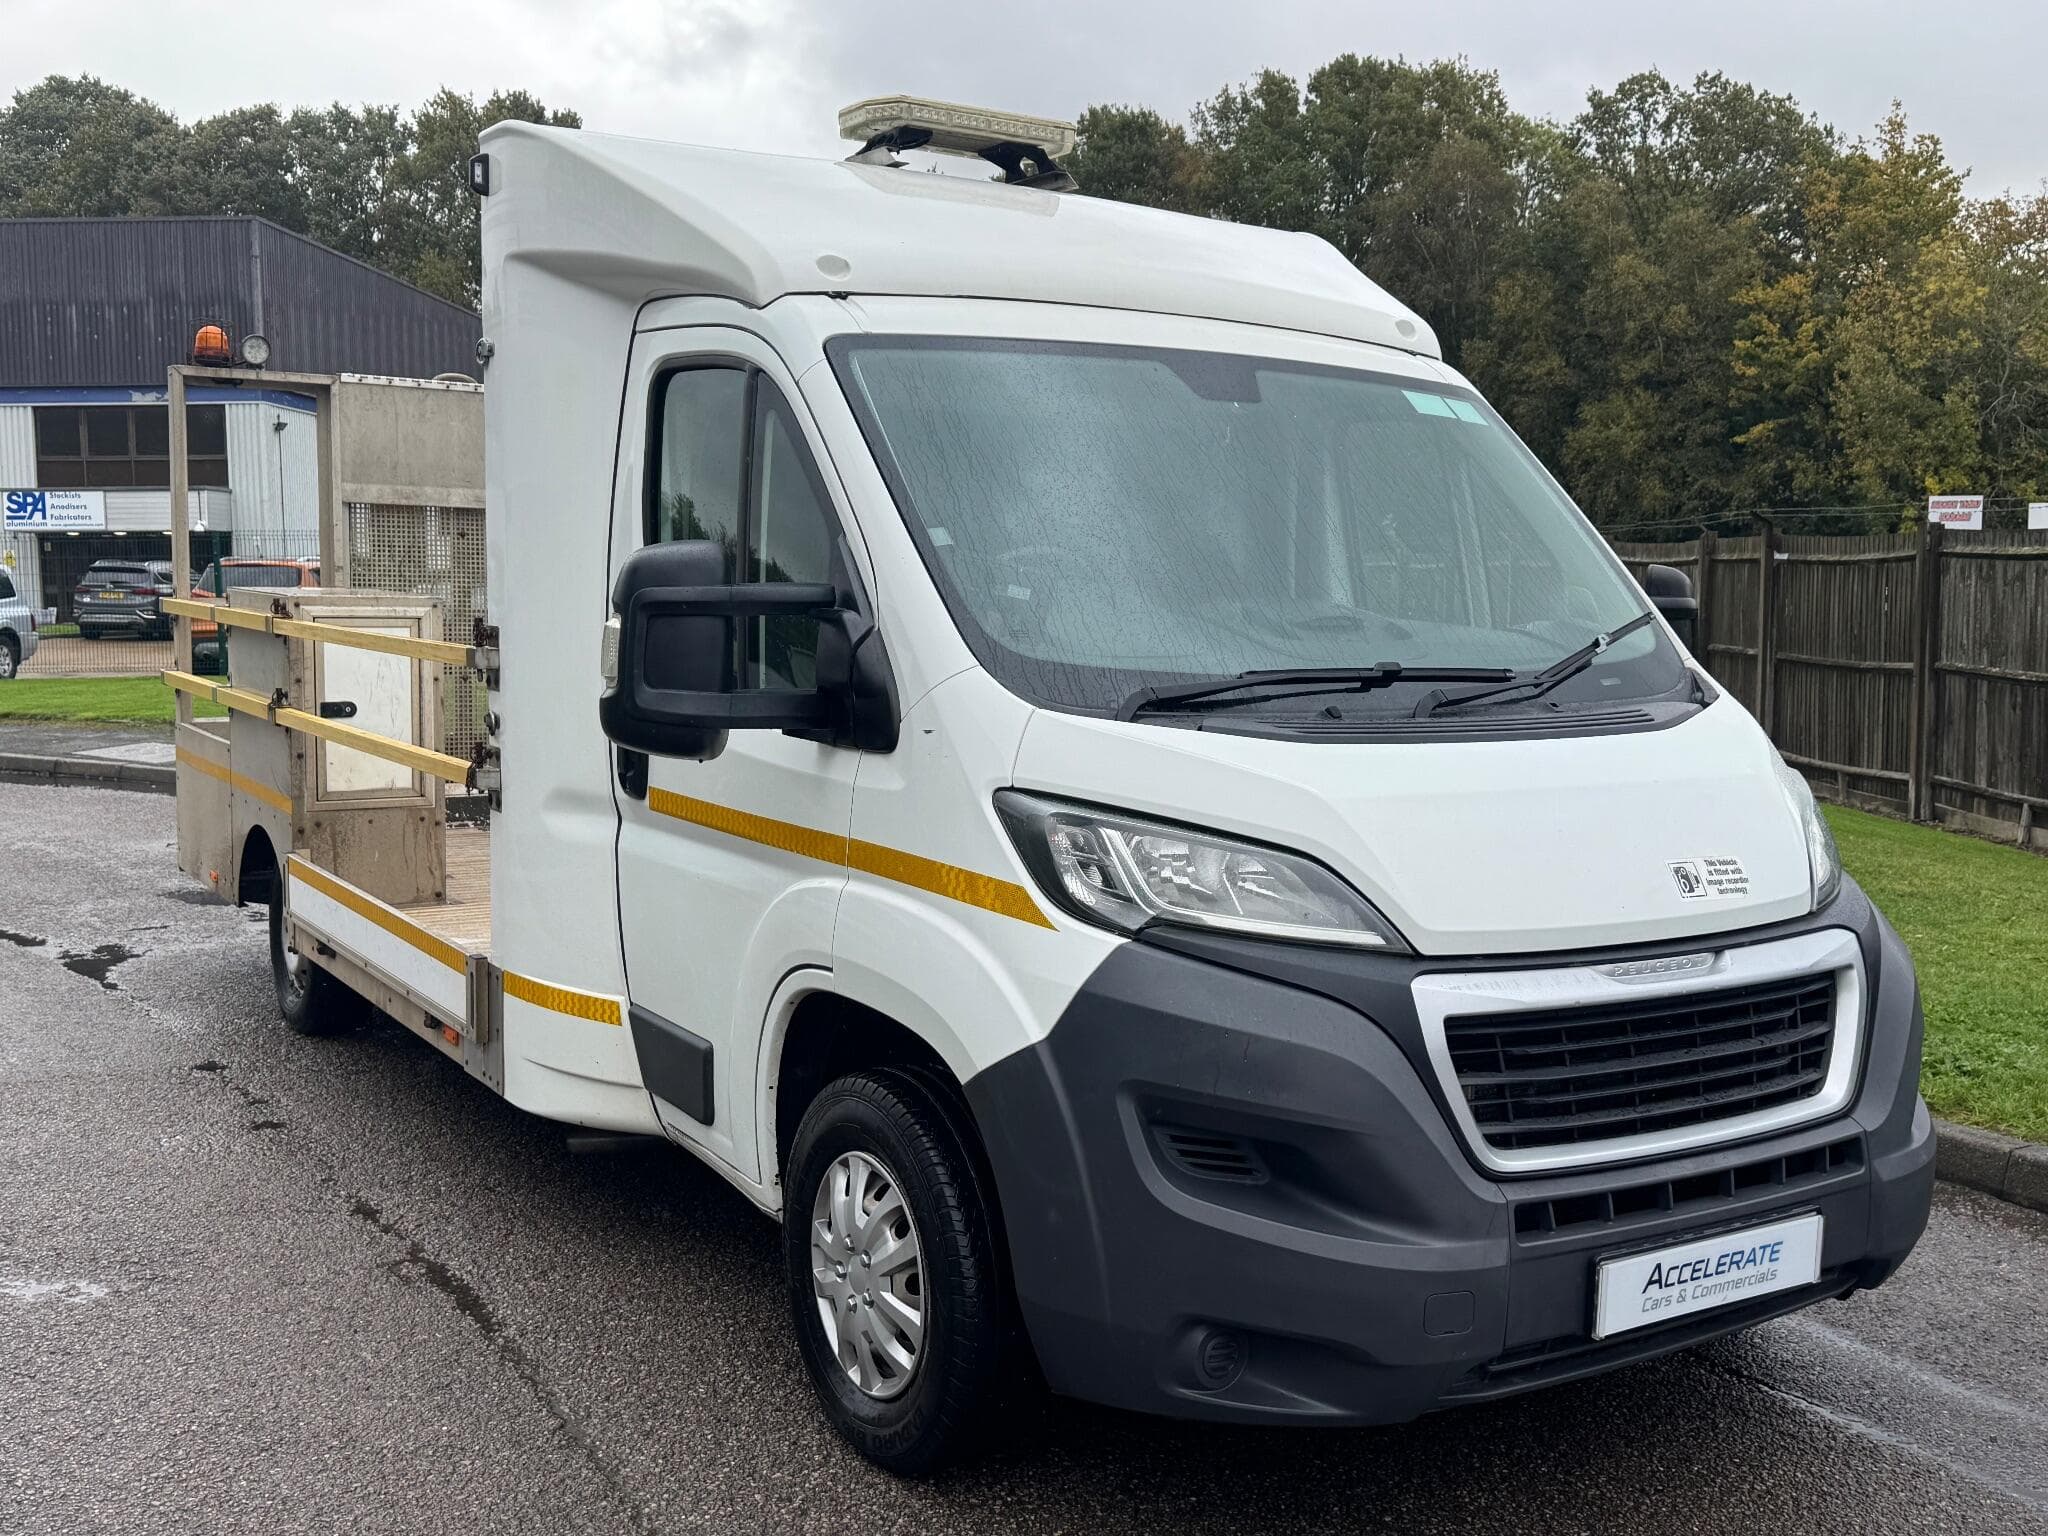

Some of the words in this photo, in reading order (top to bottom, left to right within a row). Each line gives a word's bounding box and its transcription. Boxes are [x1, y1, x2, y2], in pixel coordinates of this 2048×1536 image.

[6, 490, 46, 520] SPA
[1704, 859, 1717, 867] This
[1714, 868, 1729, 876] fitted
[1730, 866, 1743, 875] with
[1614, 956, 1706, 976] PEUGEOT
[1641, 1241, 1783, 1294] ACCELERATE
[1641, 1294, 1672, 1312] Cars
[1675, 1288, 1687, 1304] &
[1691, 1268, 1778, 1300] Commercials
